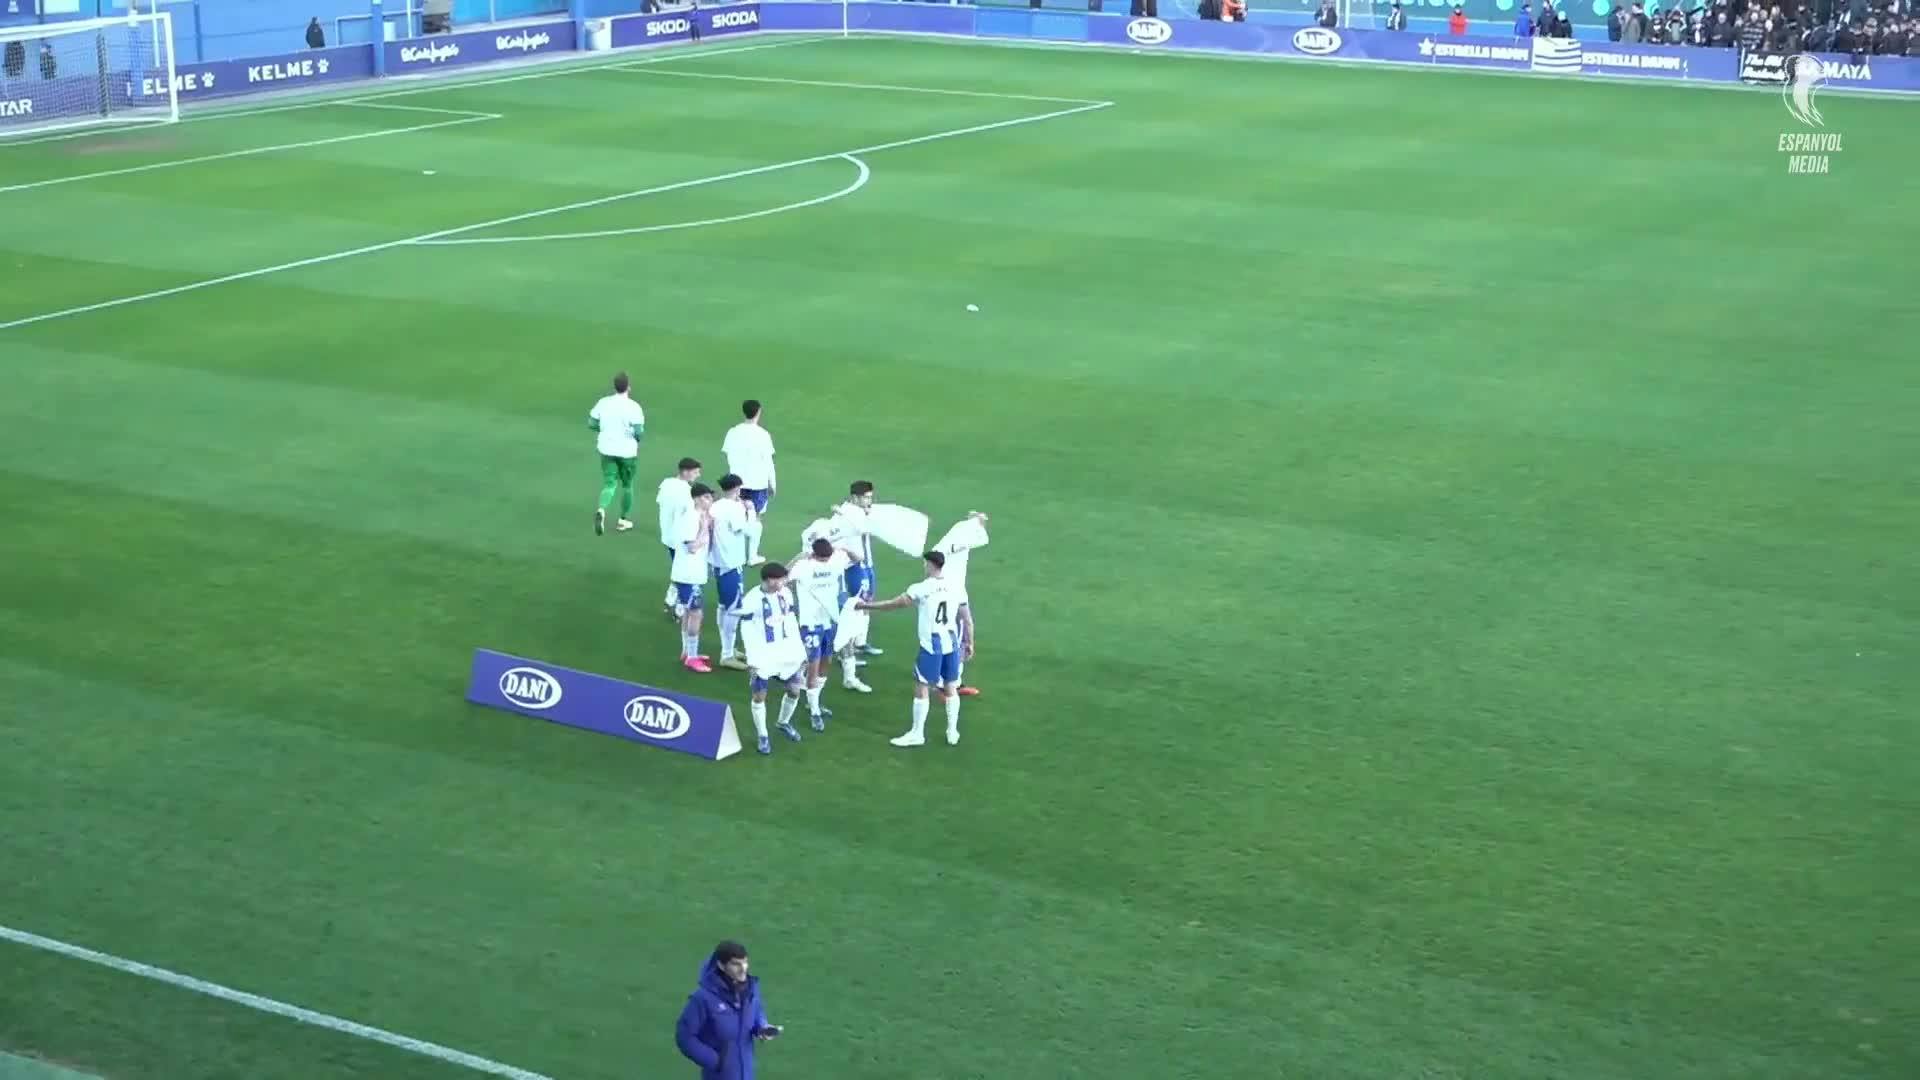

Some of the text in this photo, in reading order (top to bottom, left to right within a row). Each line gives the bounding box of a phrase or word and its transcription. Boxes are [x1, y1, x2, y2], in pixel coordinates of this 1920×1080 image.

[712, 11, 758, 28] SKODA
[248, 60, 314, 83] KELME
[127, 74, 197, 97] ELME
[935, 601, 949, 626] 4
[504, 673, 549, 702] DANI
[630, 702, 677, 732] DANI
